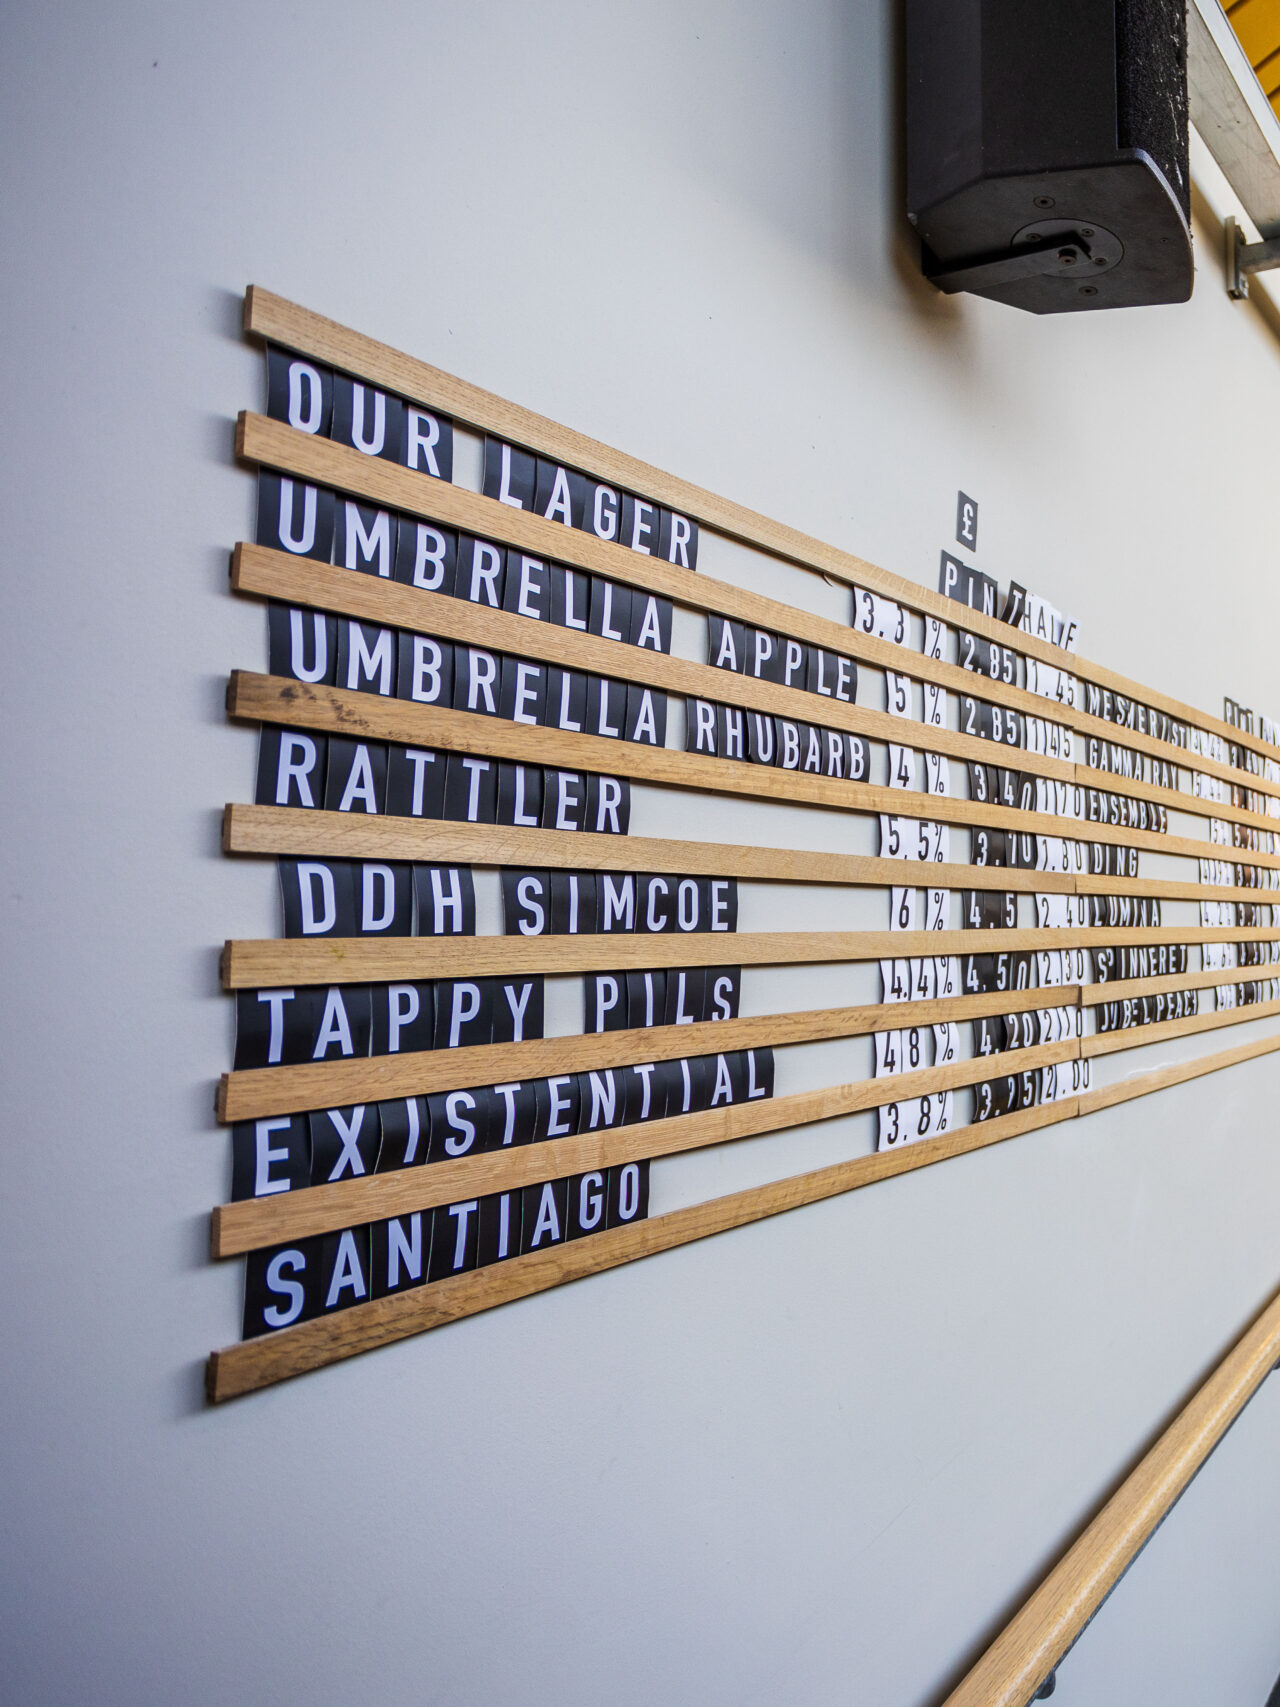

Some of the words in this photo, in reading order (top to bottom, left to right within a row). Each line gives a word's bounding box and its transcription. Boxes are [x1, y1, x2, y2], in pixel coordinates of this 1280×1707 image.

[287, 362, 441, 477] OUR
[501, 444, 691, 570] LAGER
[963, 634, 1014, 684] 2.85
[278, 477, 664, 653] UMBRELLA
[716, 619, 852, 701] APPLE
[965, 697, 1017, 744] 2.85
[288, 610, 658, 745] UMBRELLA
[695, 703, 866, 780] RHUBARB
[276, 732, 622, 834] RATTLER
[1089, 739, 1143, 782] GAMMA
[1152, 761, 1178, 791] RAY
[1089, 790, 1168, 834] ENSEMBLE
[298, 862, 465, 935] DDH
[516, 876, 730, 936] SIMCOE
[1094, 843, 1138, 879] DING
[1094, 896, 1160, 927] LUMINA
[257, 982, 533, 1064] TAPPY
[595, 971, 732, 1034] PILS
[255, 1049, 766, 1196] EXISTENTIAL
[263, 1163, 640, 1329] SANTIAGO
